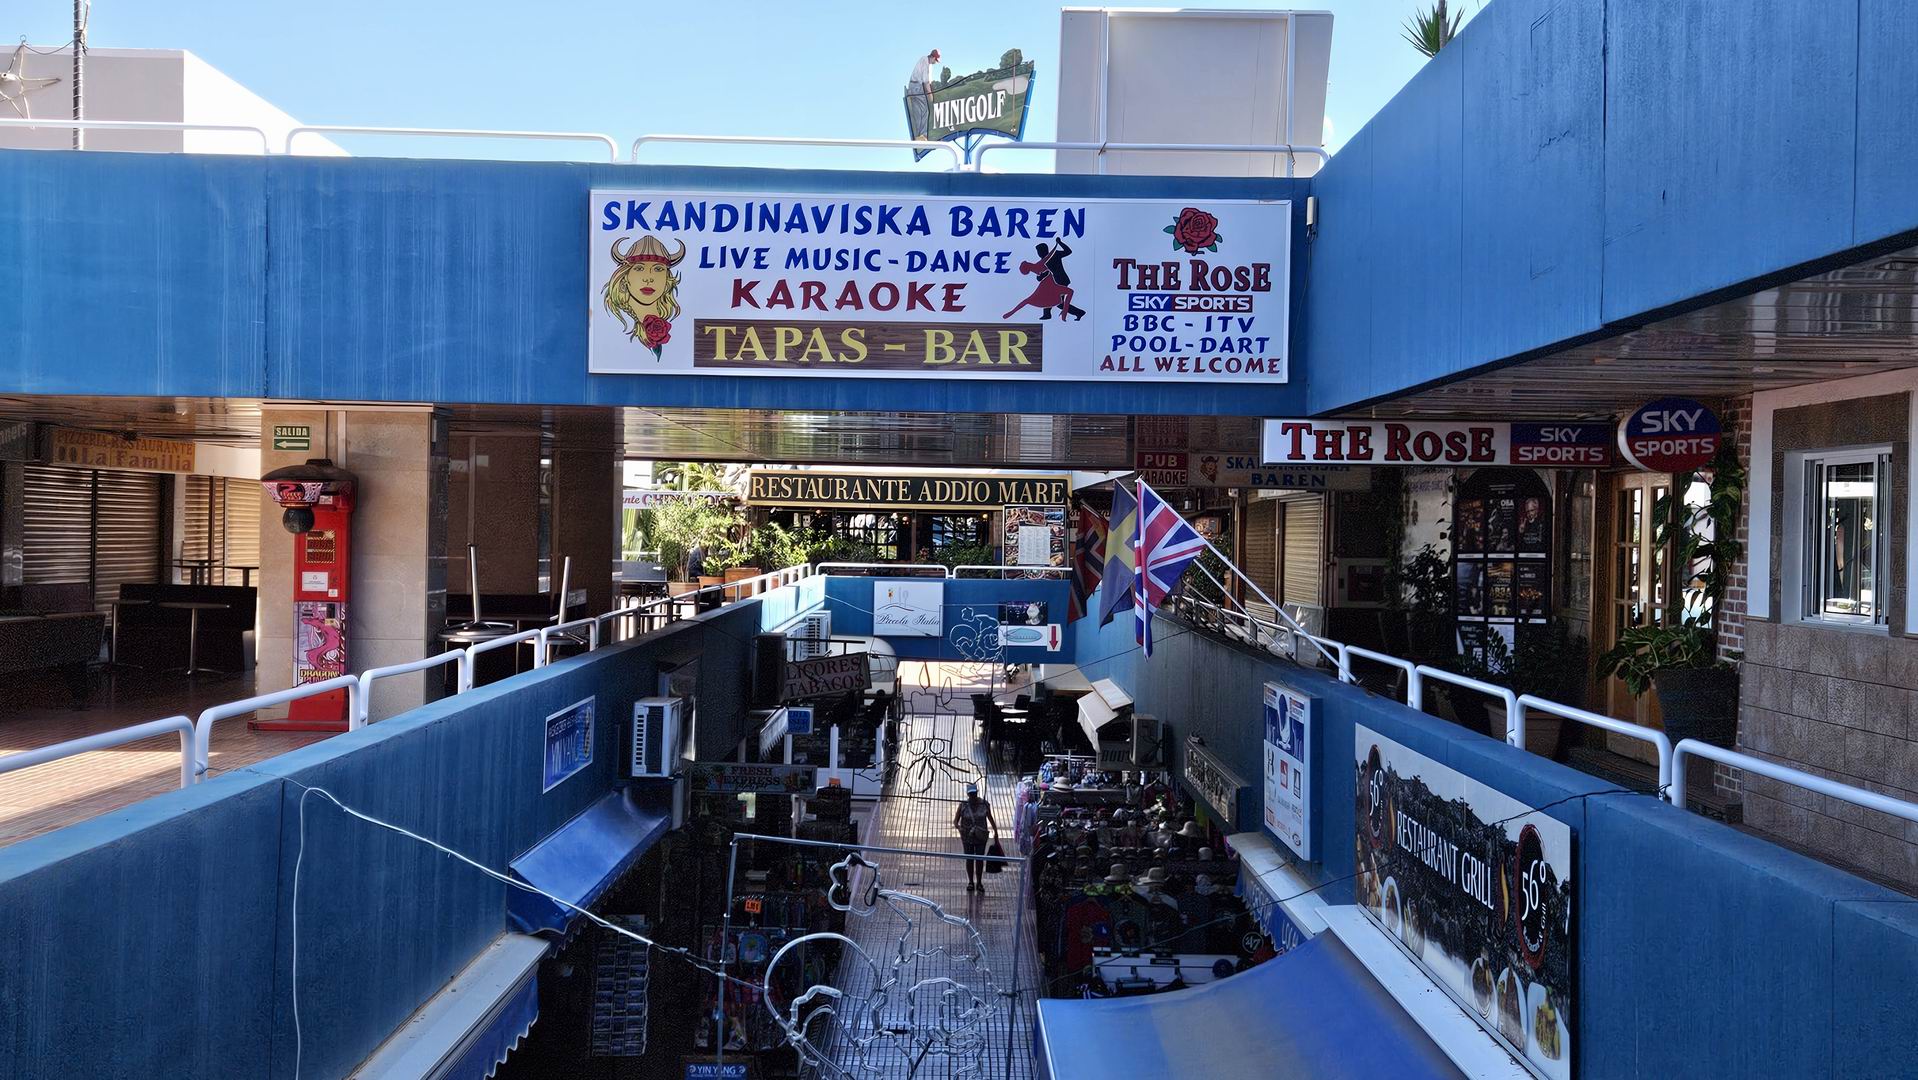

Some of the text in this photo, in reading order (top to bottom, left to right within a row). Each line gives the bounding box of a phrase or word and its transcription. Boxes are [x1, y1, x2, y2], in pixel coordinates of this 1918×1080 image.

[932, 90, 1007, 129] MINIGOLF
[602, 200, 1086, 239] SKANDINAVISKA BAREN
[699, 245, 1012, 274] LIVE MUSIC-DANCE
[1112, 258, 1272, 292] THE ROSE
[731, 278, 968, 313] KARAOKE
[1131, 295, 1250, 311] SKY SPORTS
[1122, 314, 1175, 332] BBC
[1204, 315, 1256, 334] ITV
[704, 325, 868, 363] TAPAS
[923, 328, 1032, 365] BAR
[1111, 335, 1271, 355] POOL-DART
[1099, 355, 1281, 375] ALL WELCOME
[276, 427, 308, 436] SALIDA
[1641, 408, 1705, 434] SKY
[1281, 422, 1496, 462] THE ROSE
[1540, 427, 1582, 443] SKY
[81, 447, 192, 472] La Familia
[1518, 446, 1604, 462] SPORTS
[1634, 438, 1716, 458] SPORTS
[1144, 454, 1178, 467] PUB
[751, 476, 1065, 504] RESTAURANTE ADDIO MARE
[1251, 472, 1326, 487] BAREN
[786, 656, 861, 681] LICORES
[784, 674, 865, 697] TABACOS
[1397, 810, 1459, 885] RESTAURANT
[1461, 852, 1495, 911] GRILL
[698, 1065, 711, 1074] YIN
